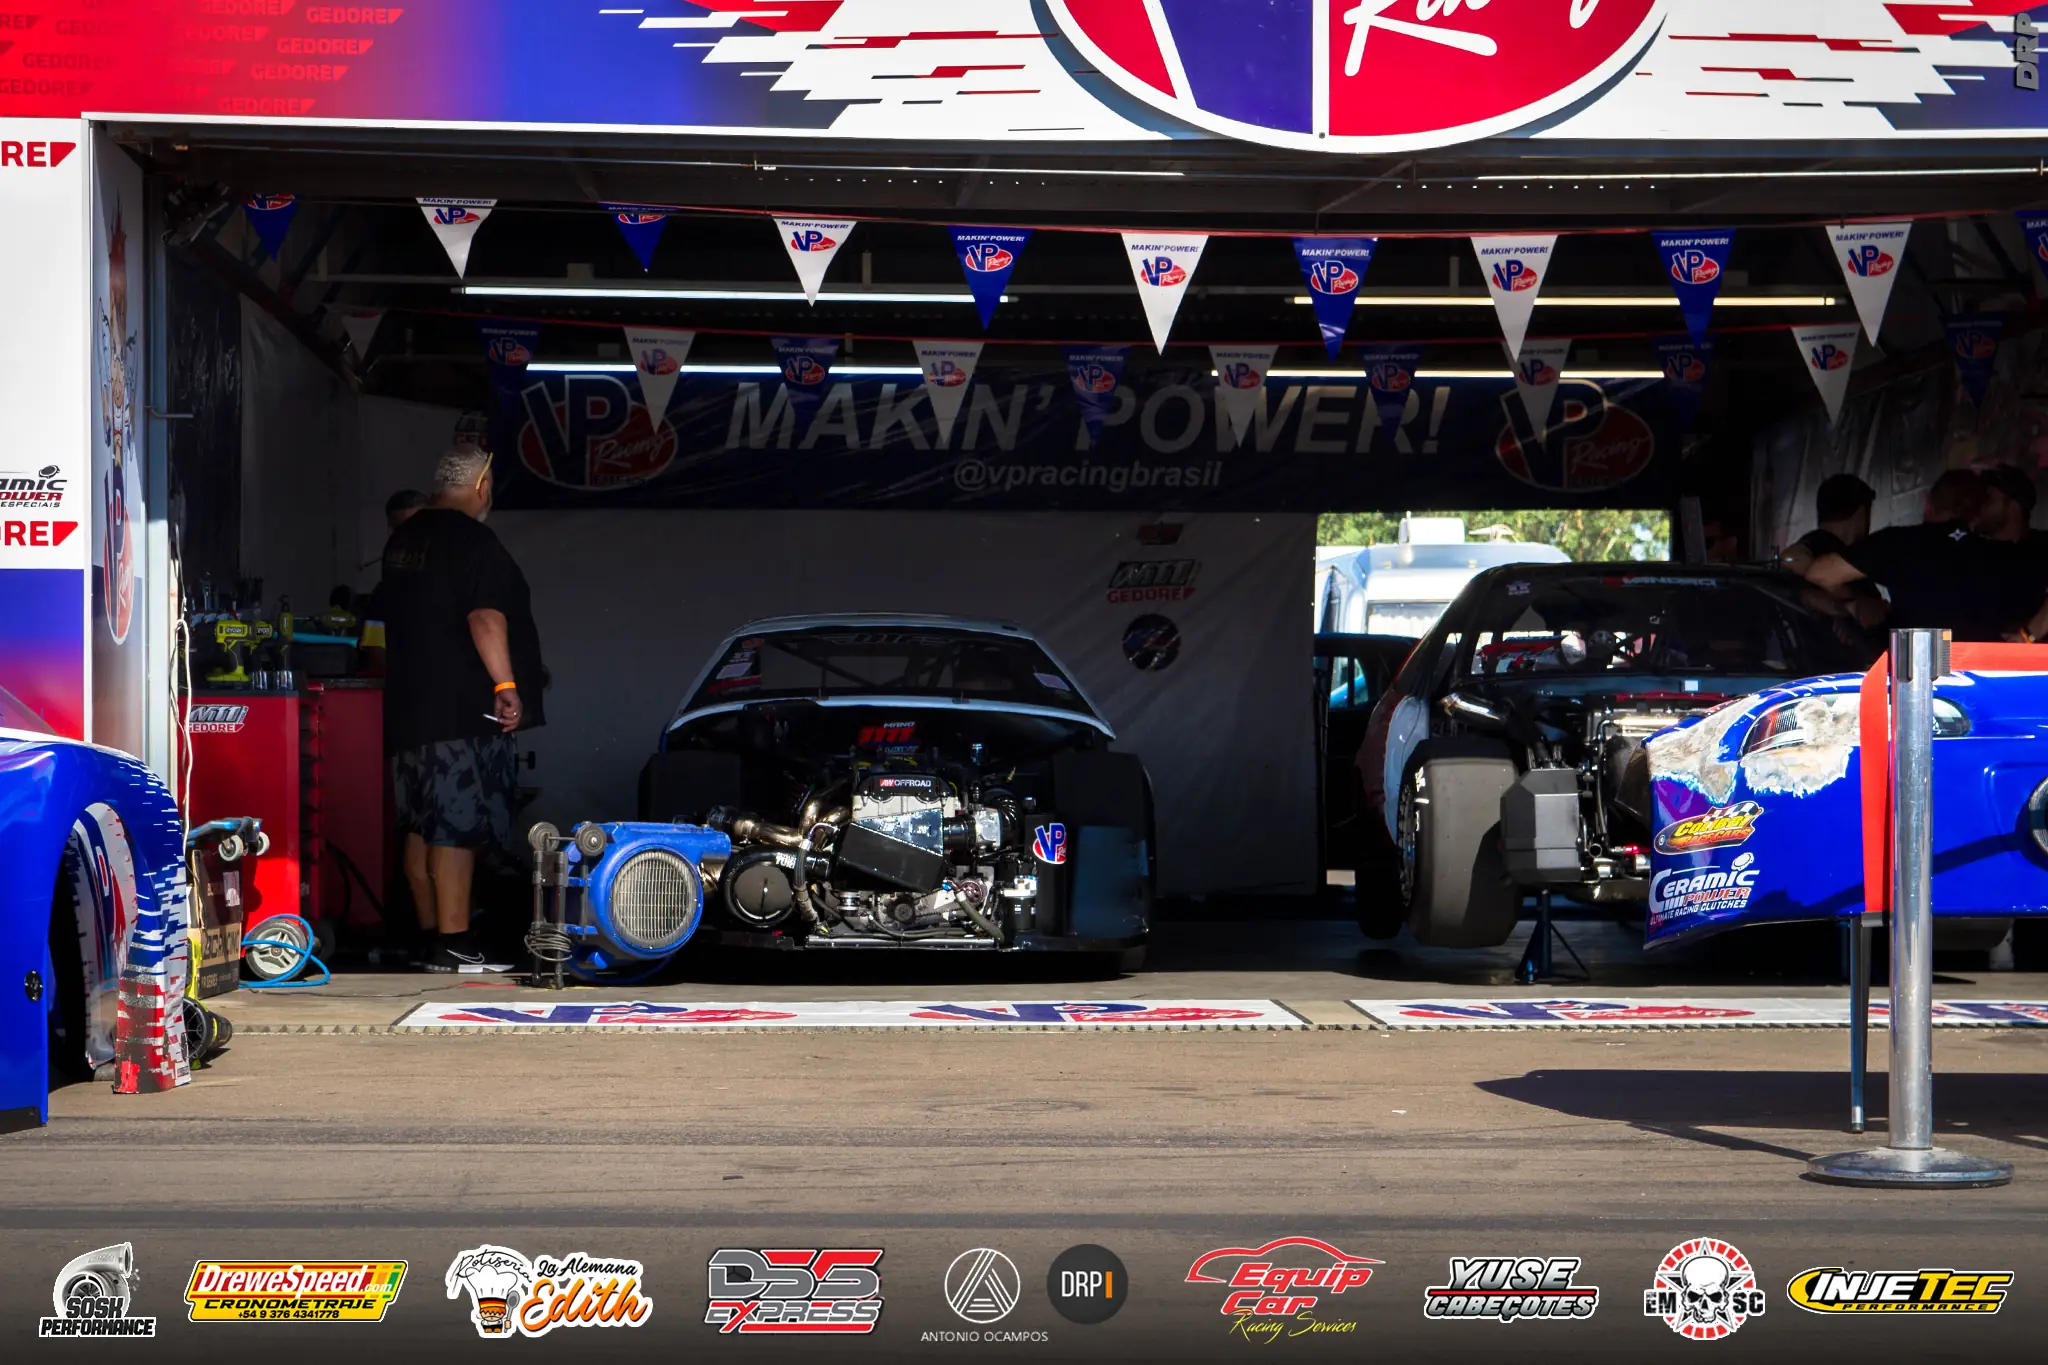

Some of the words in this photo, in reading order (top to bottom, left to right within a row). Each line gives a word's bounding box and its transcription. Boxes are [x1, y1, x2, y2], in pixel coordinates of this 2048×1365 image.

[306, 6, 388, 25] GEDORE
[277, 37, 359, 55] GEDORE
[251, 61, 333, 82] GEDORE
[436, 207, 466, 224] VP
[780, 220, 814, 228] MAKIN'
[815, 222, 849, 230] POWER!
[793, 230, 822, 251] VP
[957, 234, 990, 242] MAKIN'
[991, 235, 1025, 243] POWER!
[1131, 243, 1165, 252] MAKIN'
[1165, 244, 1199, 253] POWER!
[1661, 238, 1694, 248] MAKIN'
[1694, 237, 1729, 246] POWER!
[1836, 232, 1869, 241] MAKIN'
[1870, 231, 1904, 240] POWER!
[965, 243, 1000, 272] VP
[1301, 248, 1334, 256] MAKIN'
[1335, 248, 1370, 257] POWER!
[1480, 247, 1514, 256] MAKIN'
[1515, 246, 1549, 255] POWER!
[1848, 245, 1879, 277] VP
[1142, 256, 1173, 287] VP
[1311, 260, 1345, 294] VP
[1493, 259, 1523, 292] VP
[1671, 249, 1705, 284] VP
[488, 337, 518, 366] VP
[641, 348, 668, 376] VP
[1812, 344, 1837, 371] VP
[786, 356, 814, 385] VP
[1077, 364, 1105, 392] VP
[1224, 362, 1250, 389] VP
[1372, 362, 1401, 391] VP
[1519, 359, 1544, 386] VP
[1666, 352, 1695, 381] VP
[520, 373, 631, 488] VP
[594, 431, 674, 473] Racing
[1570, 436, 1650, 474] Racing
[953, 457, 1223, 492] @vpracingbrasil
[1107, 588, 1183, 603] GEDORE
[188, 723, 234, 732] EDORE
[895, 779, 932, 787] OFFROAD
[1034, 822, 1066, 863] VP
[1649, 868, 1760, 914] CERAMIC
[1684, 887, 1752, 906] POWER
[1674, 904, 1699, 918] RACING
[1701, 899, 1748, 912] CLUTCHES
